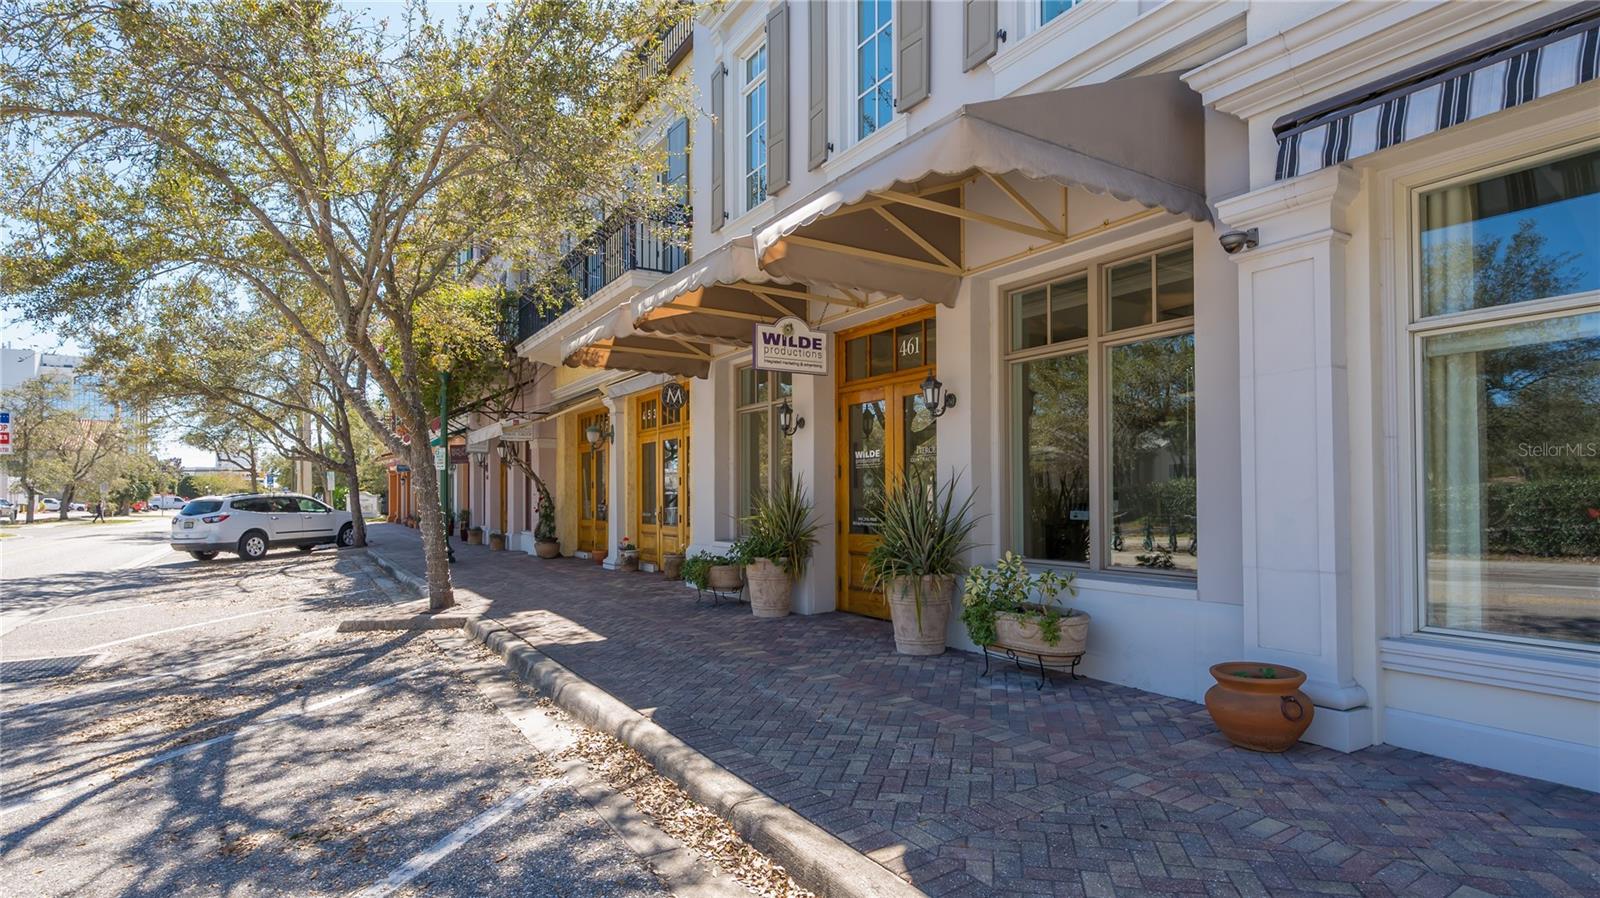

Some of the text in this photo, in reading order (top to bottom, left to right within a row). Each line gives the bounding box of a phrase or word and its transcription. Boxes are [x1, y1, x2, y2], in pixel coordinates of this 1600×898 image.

[762, 332, 822, 350] WILDE
[899, 336, 920, 357] 461
[764, 347, 823, 359] productions
[666, 388, 683, 404] M
[855, 449, 880, 459] WILDE
